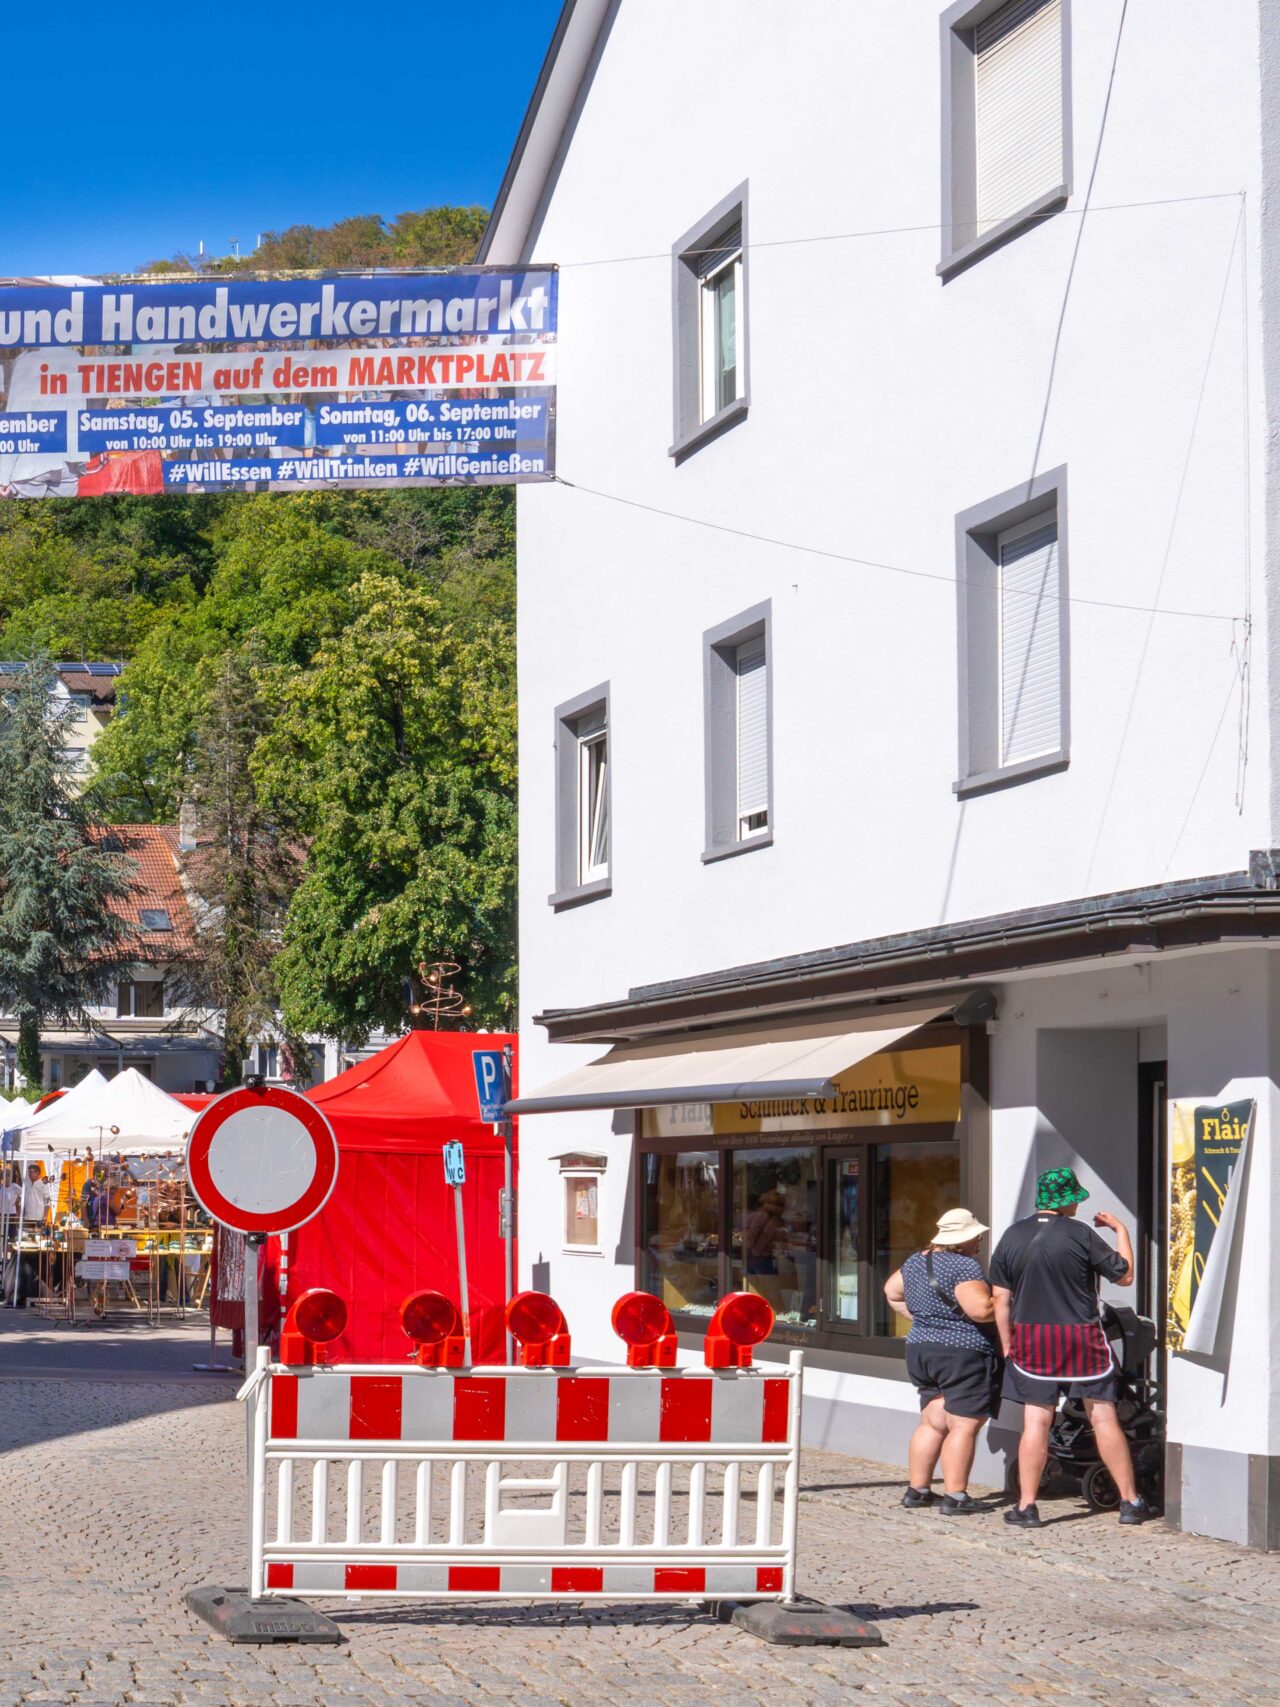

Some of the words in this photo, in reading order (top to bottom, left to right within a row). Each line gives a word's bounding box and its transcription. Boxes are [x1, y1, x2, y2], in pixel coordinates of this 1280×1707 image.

[102, 279, 549, 342] Handwerkermarkt
[40, 363, 68, 395] in
[77, 360, 203, 395] TIENGEN
[213, 356, 265, 390] auf
[272, 357, 338, 389] dem
[348, 351, 547, 387] MARKTPLATZ
[79, 409, 165, 435] Samstag,
[169, 409, 198, 428] 05.
[201, 407, 303, 433] September
[319, 403, 401, 427] Sonntag,
[405, 403, 435, 422] 06.
[438, 401, 542, 426] September
[18, 437, 40, 453] Uhr
[105, 437, 128, 450] von
[132, 435, 167, 449] 10:00
[169, 434, 193, 447] Uhr
[194, 433, 214, 447] bis
[218, 433, 253, 447] 19:00
[256, 432, 277, 446] Uhr
[344, 431, 367, 443] von
[370, 429, 405, 443] 11:00
[408, 428, 431, 442] Uhr
[433, 427, 453, 441] bis
[456, 427, 492, 440] 17:00
[494, 426, 517, 440] Uhr
[168, 460, 272, 483] #WillEssen
[277, 456, 399, 480] #WillTrinken
[403, 452, 545, 477] #WillGenießen
[481, 1055, 496, 1100] P
[831, 1079, 919, 1119] Trauringe
